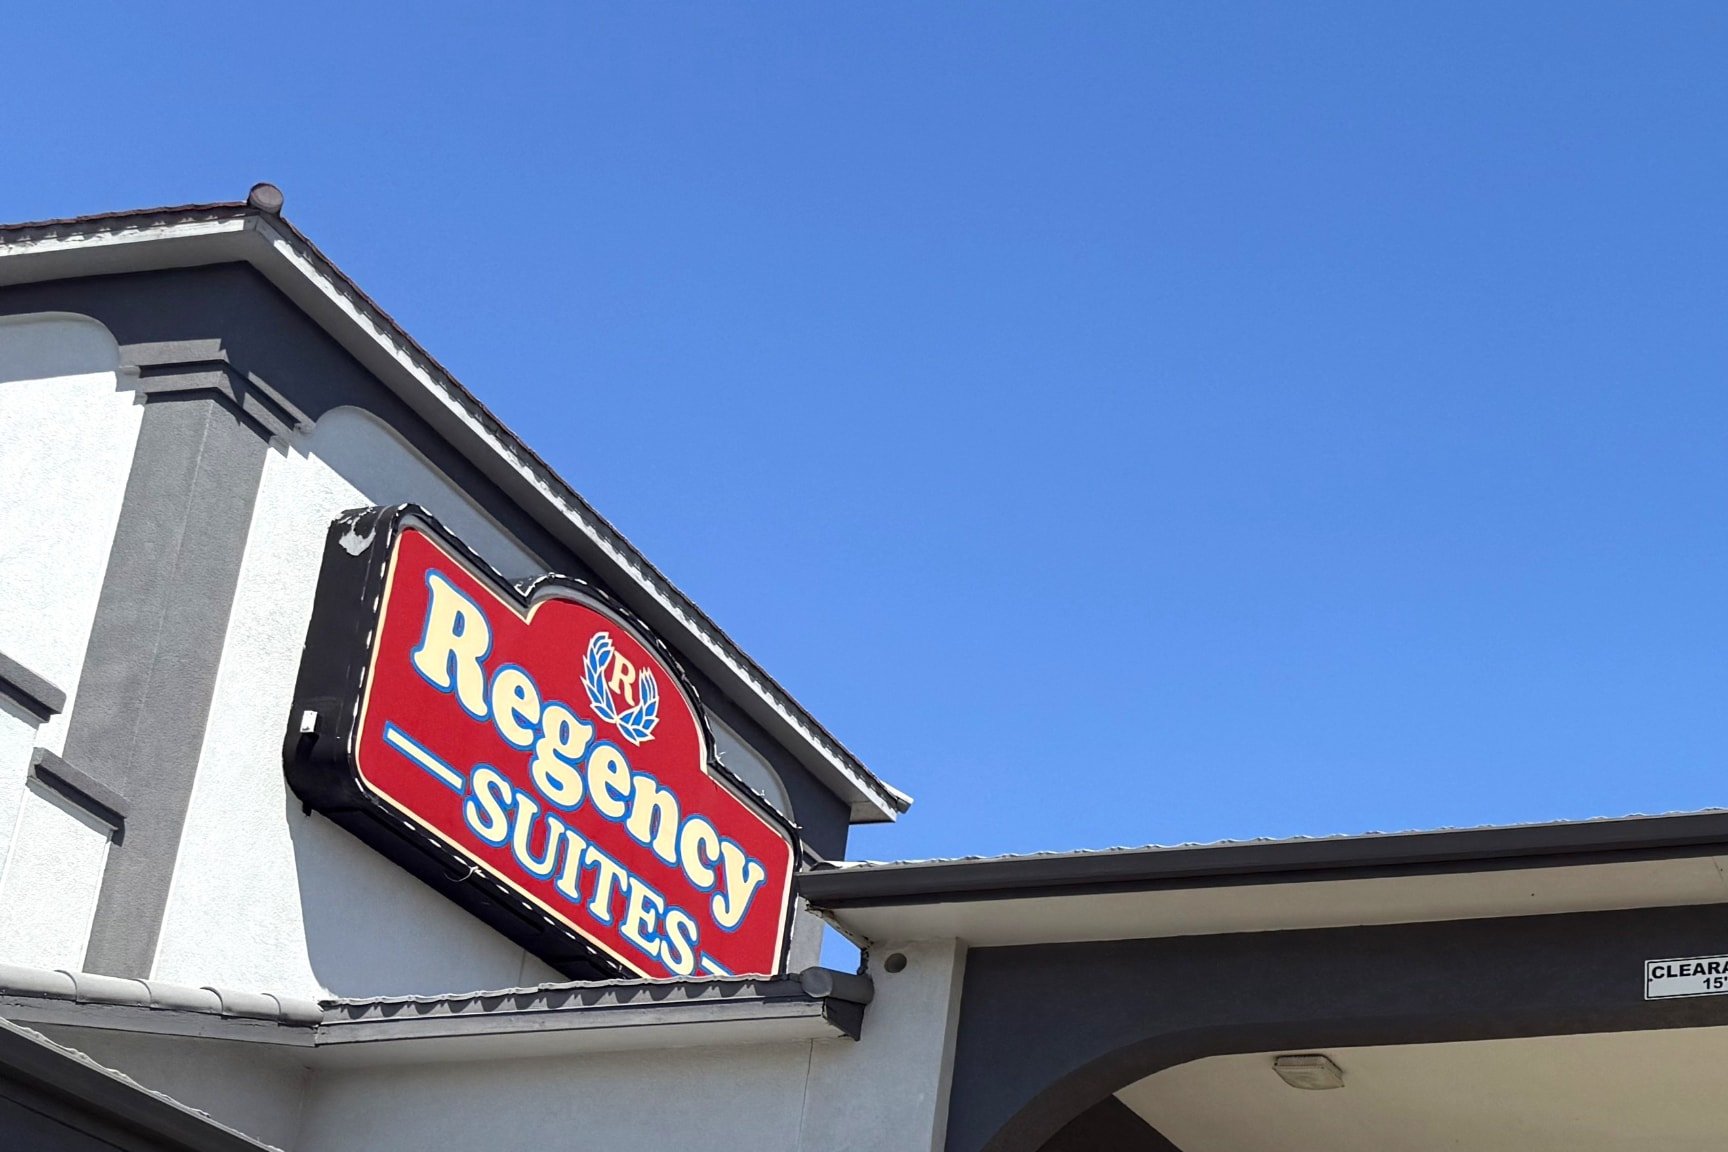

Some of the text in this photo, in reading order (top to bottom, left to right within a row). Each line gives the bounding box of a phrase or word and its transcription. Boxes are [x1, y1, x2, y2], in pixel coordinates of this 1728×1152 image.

[608, 648, 637, 707] R
[411, 568, 768, 933] Regency
[464, 763, 699, 976] SUITES
[1703, 976, 1728, 990] 15'
